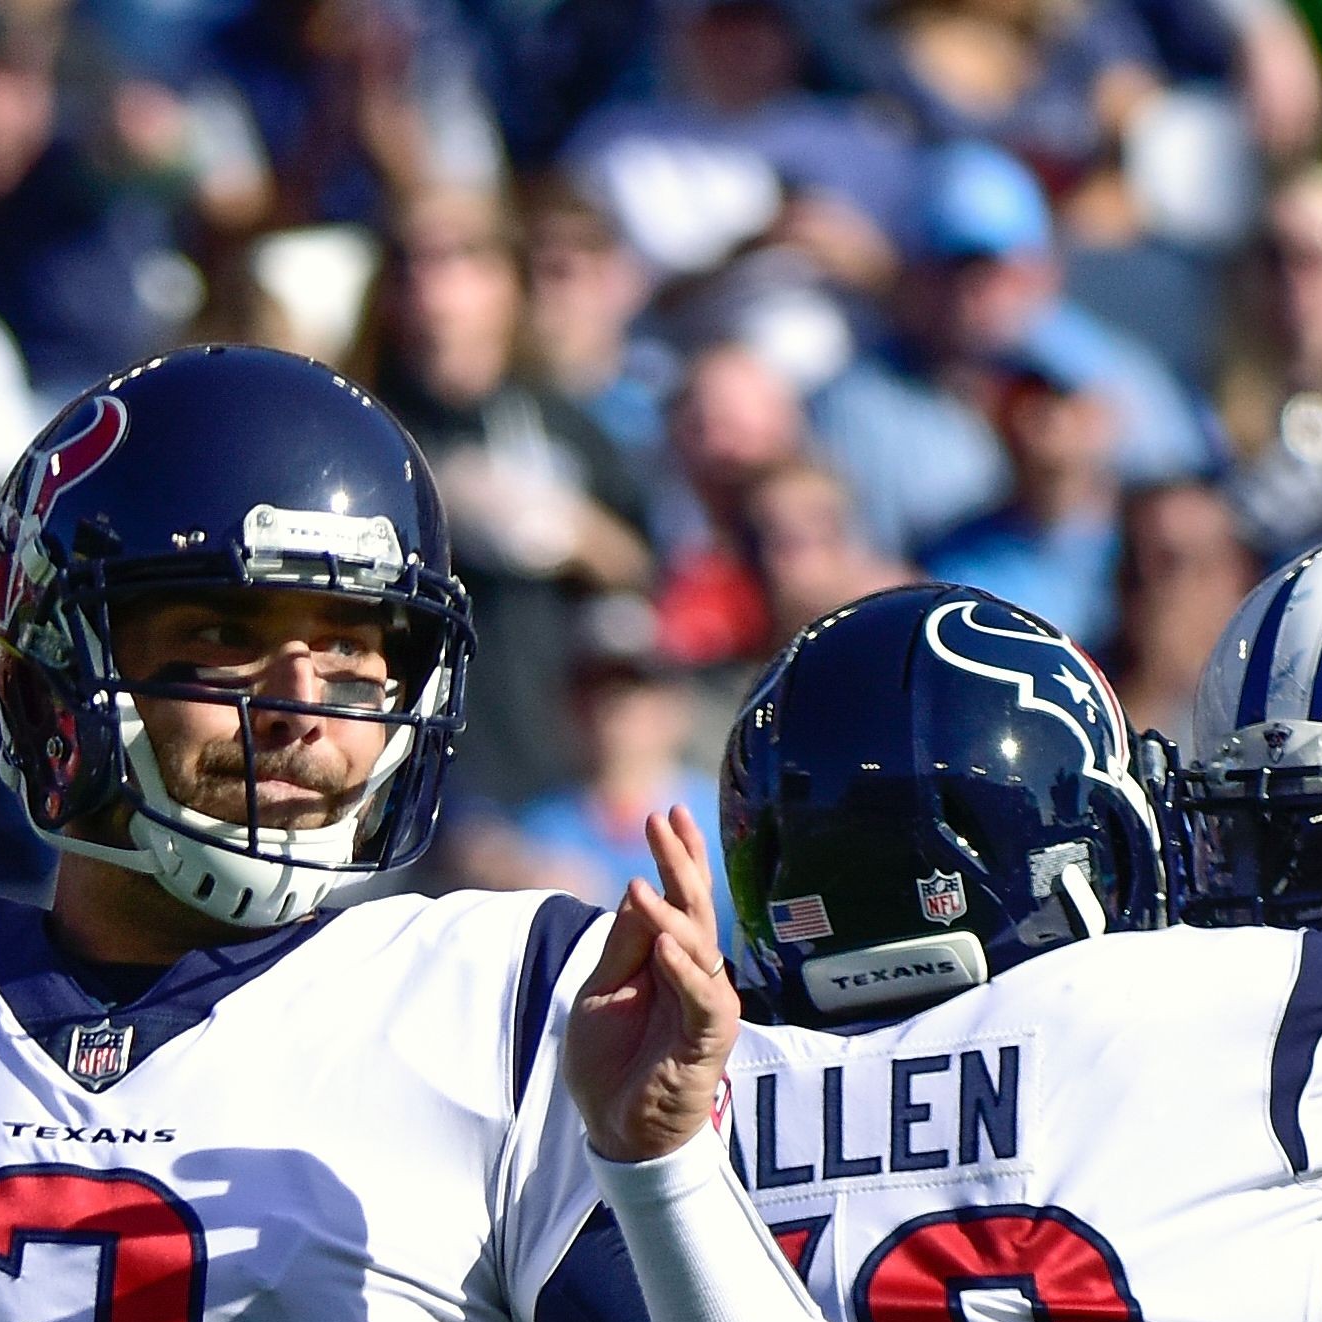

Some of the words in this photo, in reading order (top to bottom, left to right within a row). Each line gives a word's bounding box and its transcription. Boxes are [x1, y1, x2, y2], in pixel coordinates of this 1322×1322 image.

[928, 893, 963, 916] NFL
[831, 959, 957, 991] TEXANS
[77, 1045, 118, 1076] NFL
[2, 1119, 178, 1144] TEXANS
[728, 1045, 1020, 1192] LLEN
